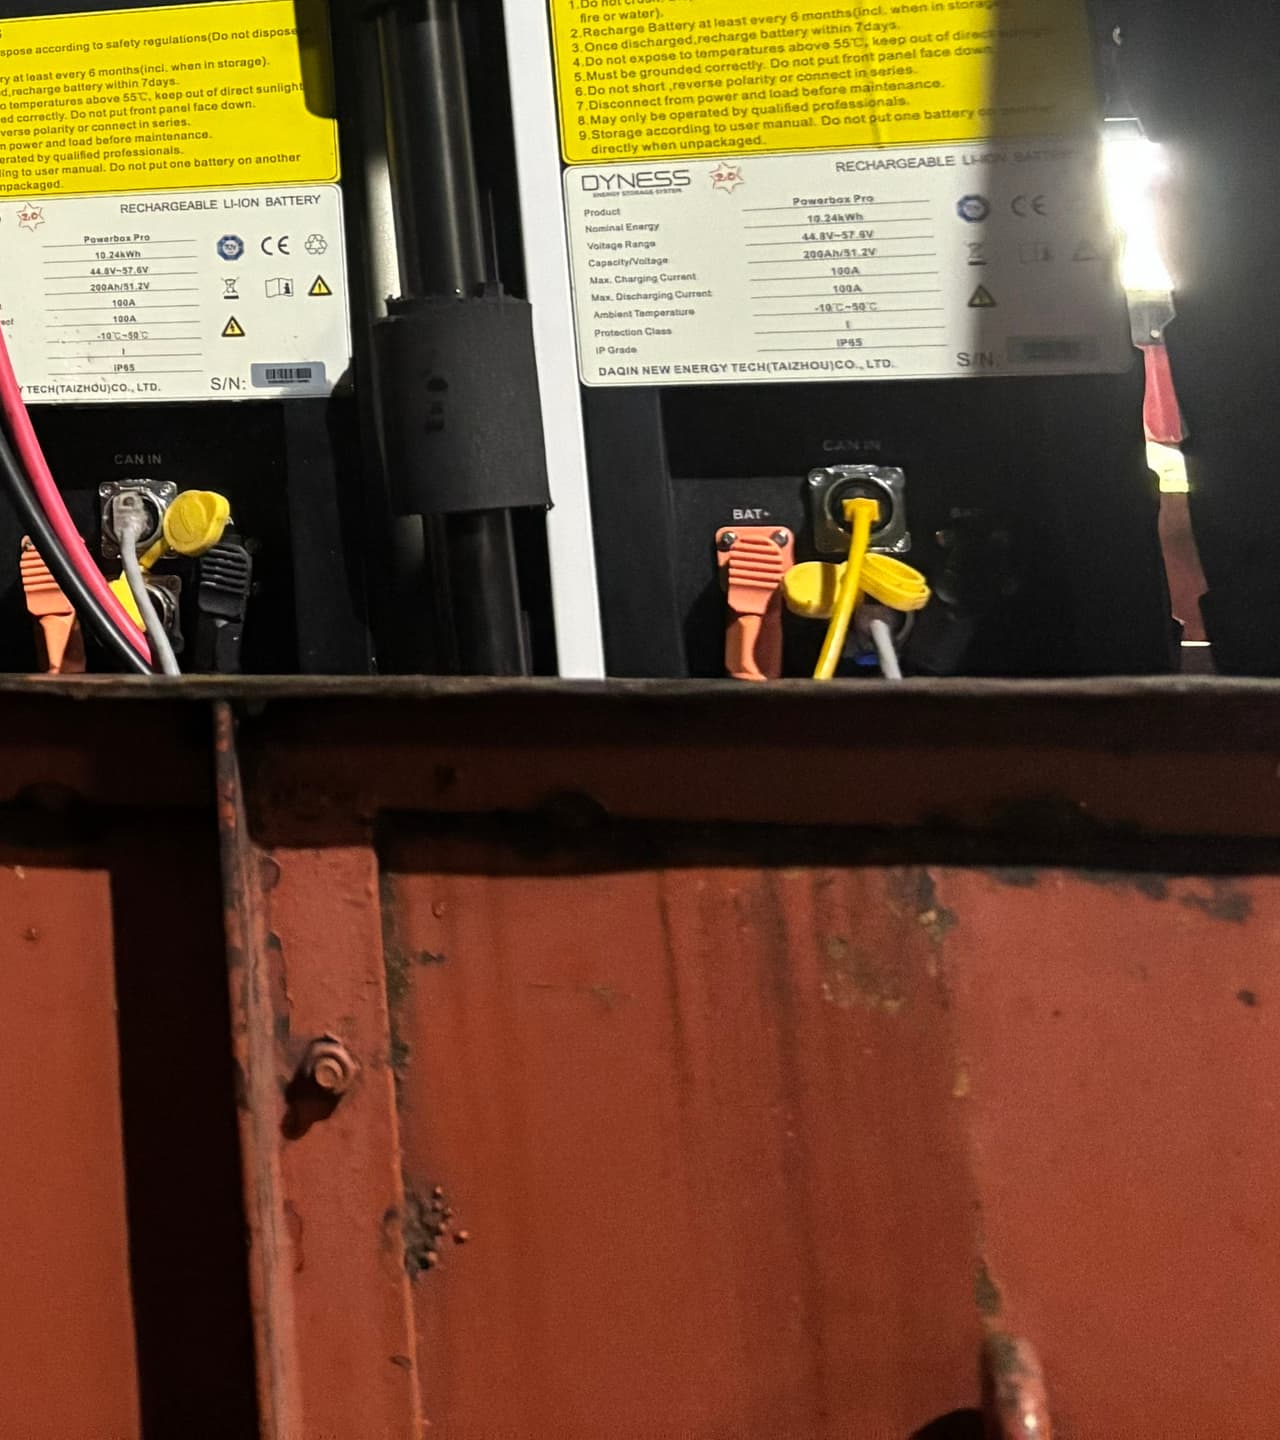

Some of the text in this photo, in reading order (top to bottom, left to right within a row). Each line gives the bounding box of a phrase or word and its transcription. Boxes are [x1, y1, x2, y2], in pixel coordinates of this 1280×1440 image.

[579, 6, 664, 24] fire or water).
[34, 41, 90, 54] according
[91, 41, 104, 50] to
[104, 38, 141, 49] safety
[142, 30, 229, 48] regulations(Do
[230, 28, 250, 40] not
[570, 20, 900, 53] 3.Once discharged,recharge battery within 7days.
[12, 73, 24, 83] at
[25, 71, 53, 82] least
[54, 70, 86, 81] every
[87, 67, 96, 78] 6
[97, 62, 168, 77] months(incl.
[169, 61, 202, 71] when
[203, 59, 215, 69] in
[216, 55, 270, 69] storage).
[575, 79, 945, 111] 7.Disconnect from power and load before maintenance.
[576, 95, 910, 127] 8.May only be operated by qualified professionals.
[590, 134, 767, 155] directly when unpackaged.
[20, 167, 33, 177] to
[33, 166, 59, 176] user
[60, 162, 106, 174] manual.
[108, 161, 126, 172] Do
[127, 160, 147, 171] not
[147, 159, 168, 172] put
[168, 159, 191, 169] one
[193, 157, 235, 168] battery
[236, 156, 252, 165] on
[254, 152, 301, 164] another
[834, 154, 956, 172] RECHARGEABLE
[580, 168, 691, 192] DYNESS
[119, 193, 321, 214] RECHARGEABLE LI-ION BATTERY
[597, 358, 895, 377] DAQIN NEW ENERGY TECH(TAIZHOU)CO., LTD.
[209, 376, 246, 391] S/N:
[113, 453, 163, 465] CAN IN
[732, 508, 771, 521] BAT+
